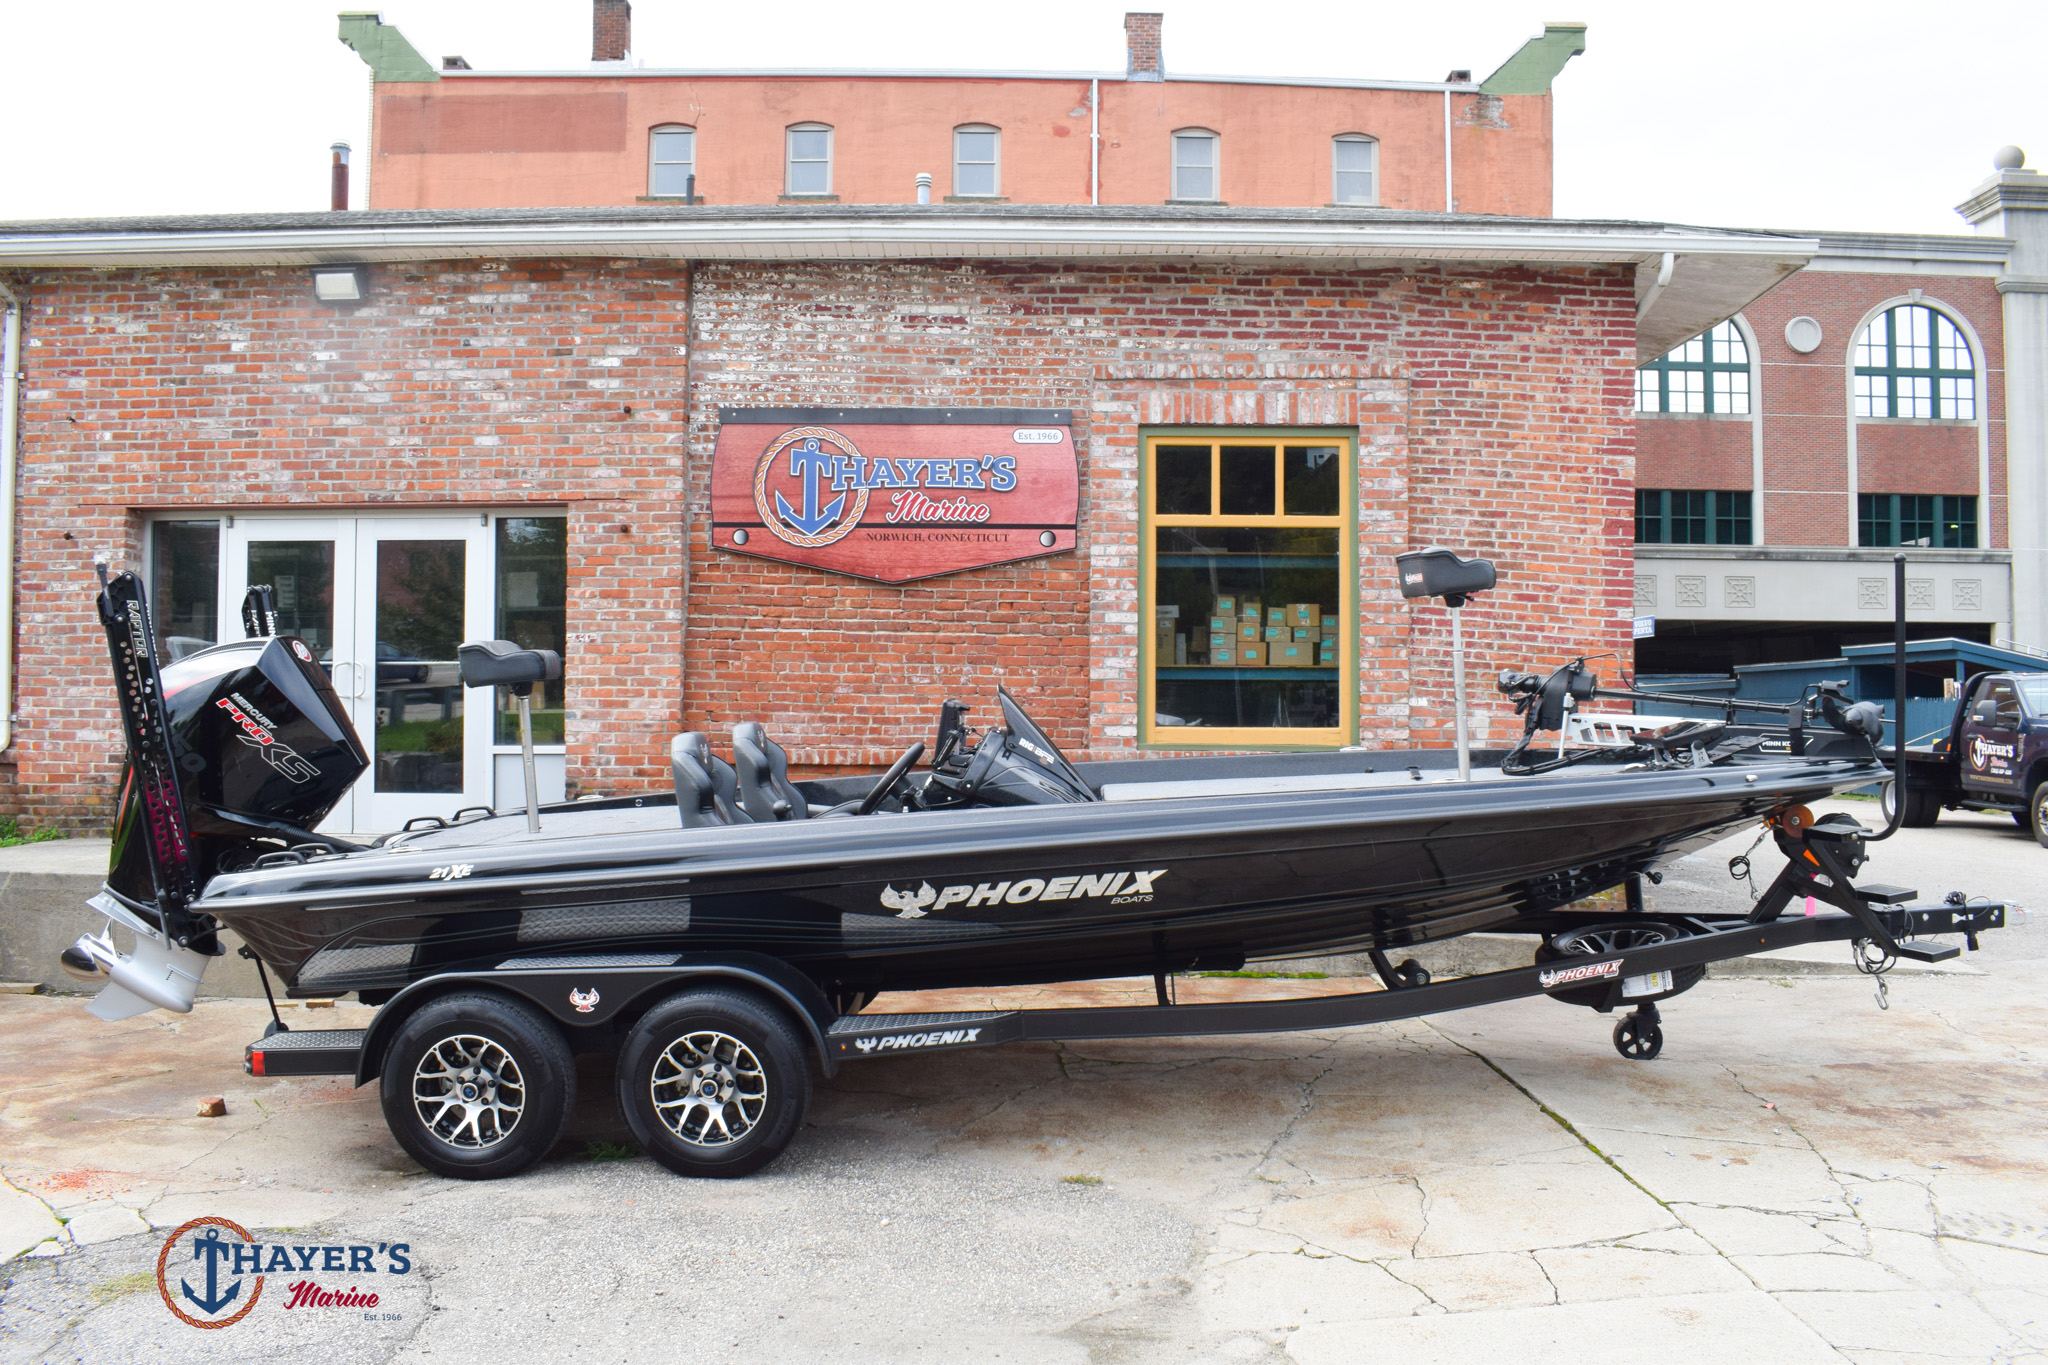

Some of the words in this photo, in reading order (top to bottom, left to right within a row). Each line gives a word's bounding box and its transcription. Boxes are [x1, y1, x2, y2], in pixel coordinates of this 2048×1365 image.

[1018, 432, 1035, 441] Est.
[1037, 432, 1059, 441] 1966
[886, 490, 990, 523] Marine
[866, 532, 925, 543] NORWICH,
[927, 533, 1010, 543] CONNECTICUT
[126, 599, 149, 658] RAPTOR
[215, 697, 275, 746] PRO
[230, 692, 278, 730] MERCURY
[235, 734, 321, 783] XS
[932, 868, 1169, 911] PHOENIX
[1110, 894, 1154, 905] BOATS
[1555, 960, 1623, 982] PHOENIX
[876, 1028, 983, 1051] PHOENIX
